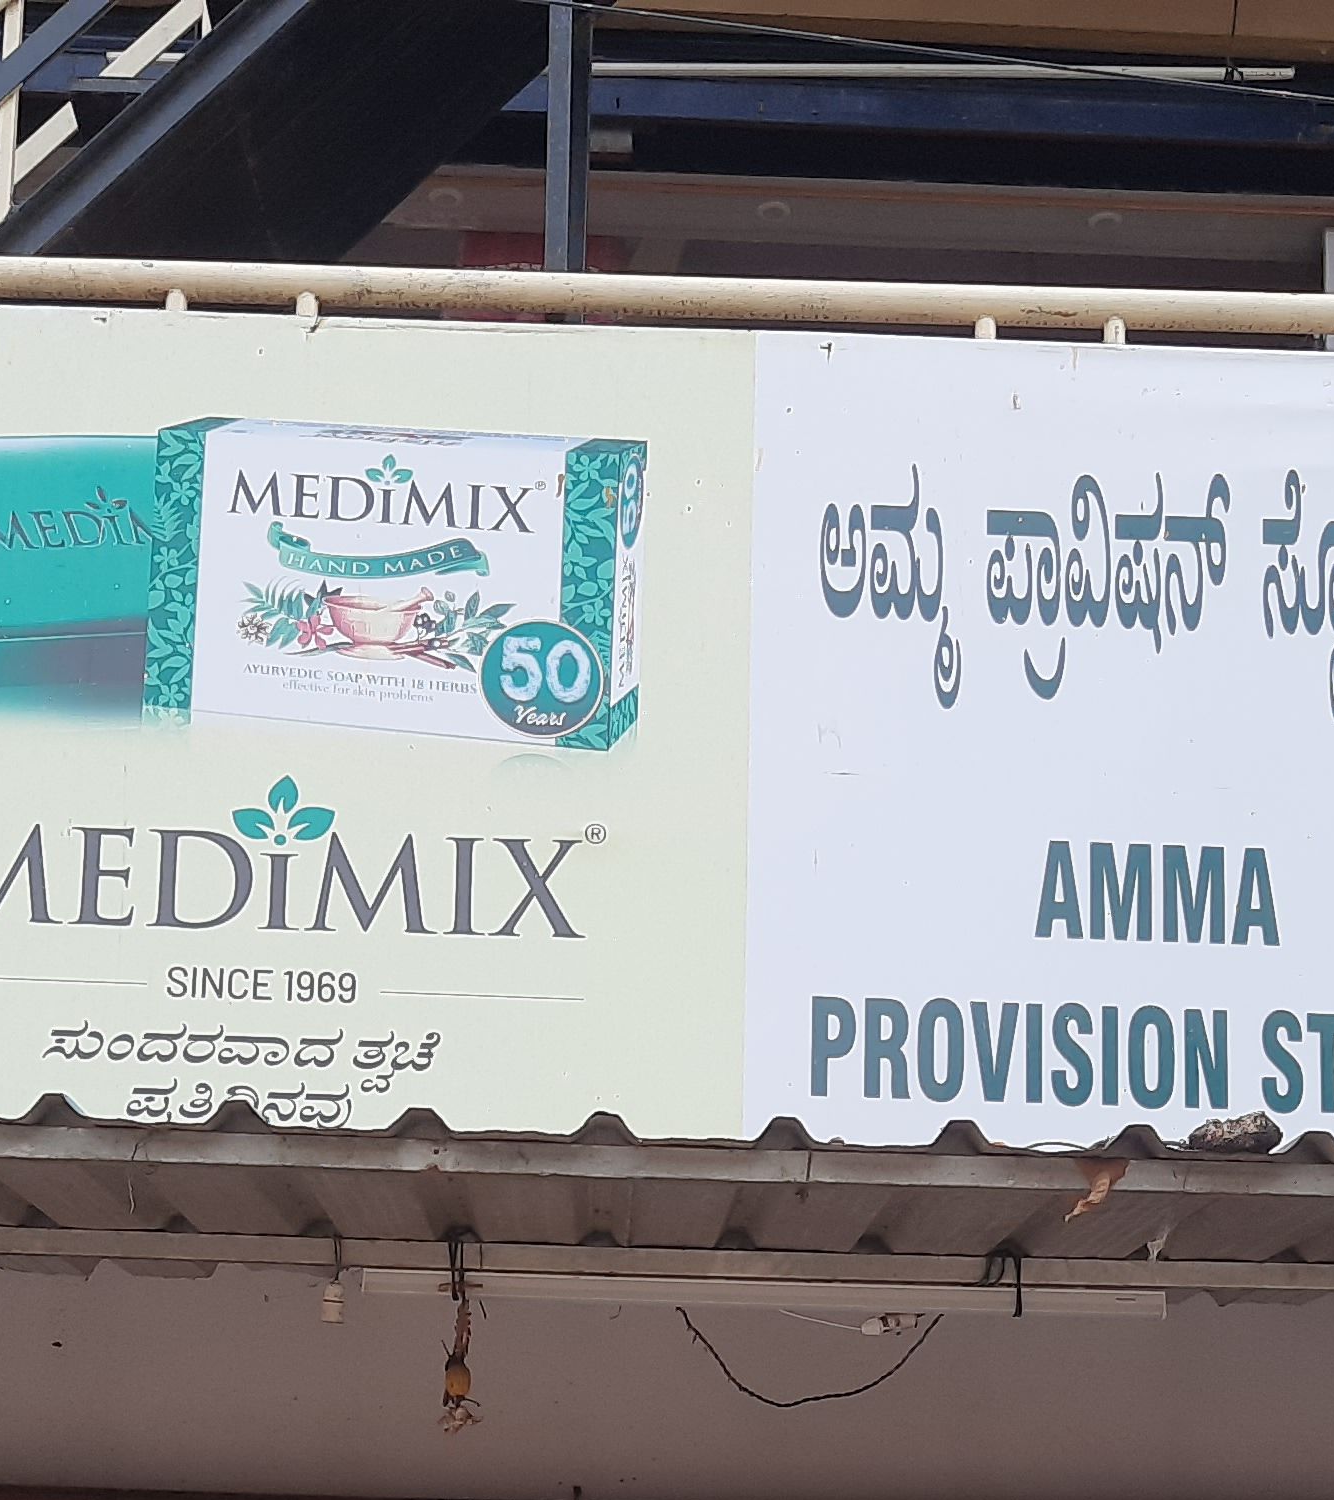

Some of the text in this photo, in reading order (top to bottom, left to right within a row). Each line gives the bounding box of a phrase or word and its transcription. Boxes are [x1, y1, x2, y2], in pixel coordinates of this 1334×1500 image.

[287, 545, 467, 576] HAND MADE
[819, 463, 962, 711] ಅಮ್ಮ
[244, 662, 323, 681] AYURVEDIC
[326, 668, 364, 685] SOAP
[366, 673, 406, 689] WITH
[428, 678, 478, 695] HERBS
[282, 679, 331, 695] effective
[332, 682, 351, 696] for
[378, 689, 435, 705] problems
[498, 636, 592, 703] 50
[514, 704, 567, 729] Years
[1034, 840, 1281, 947] AMMA
[165, 965, 358, 1005] SINCE 1969
[42, 1020, 442, 1094] ಸುಂದರವಾದ ತ್ವಚೆ
[810, 995, 1229, 1110] PROVISION
